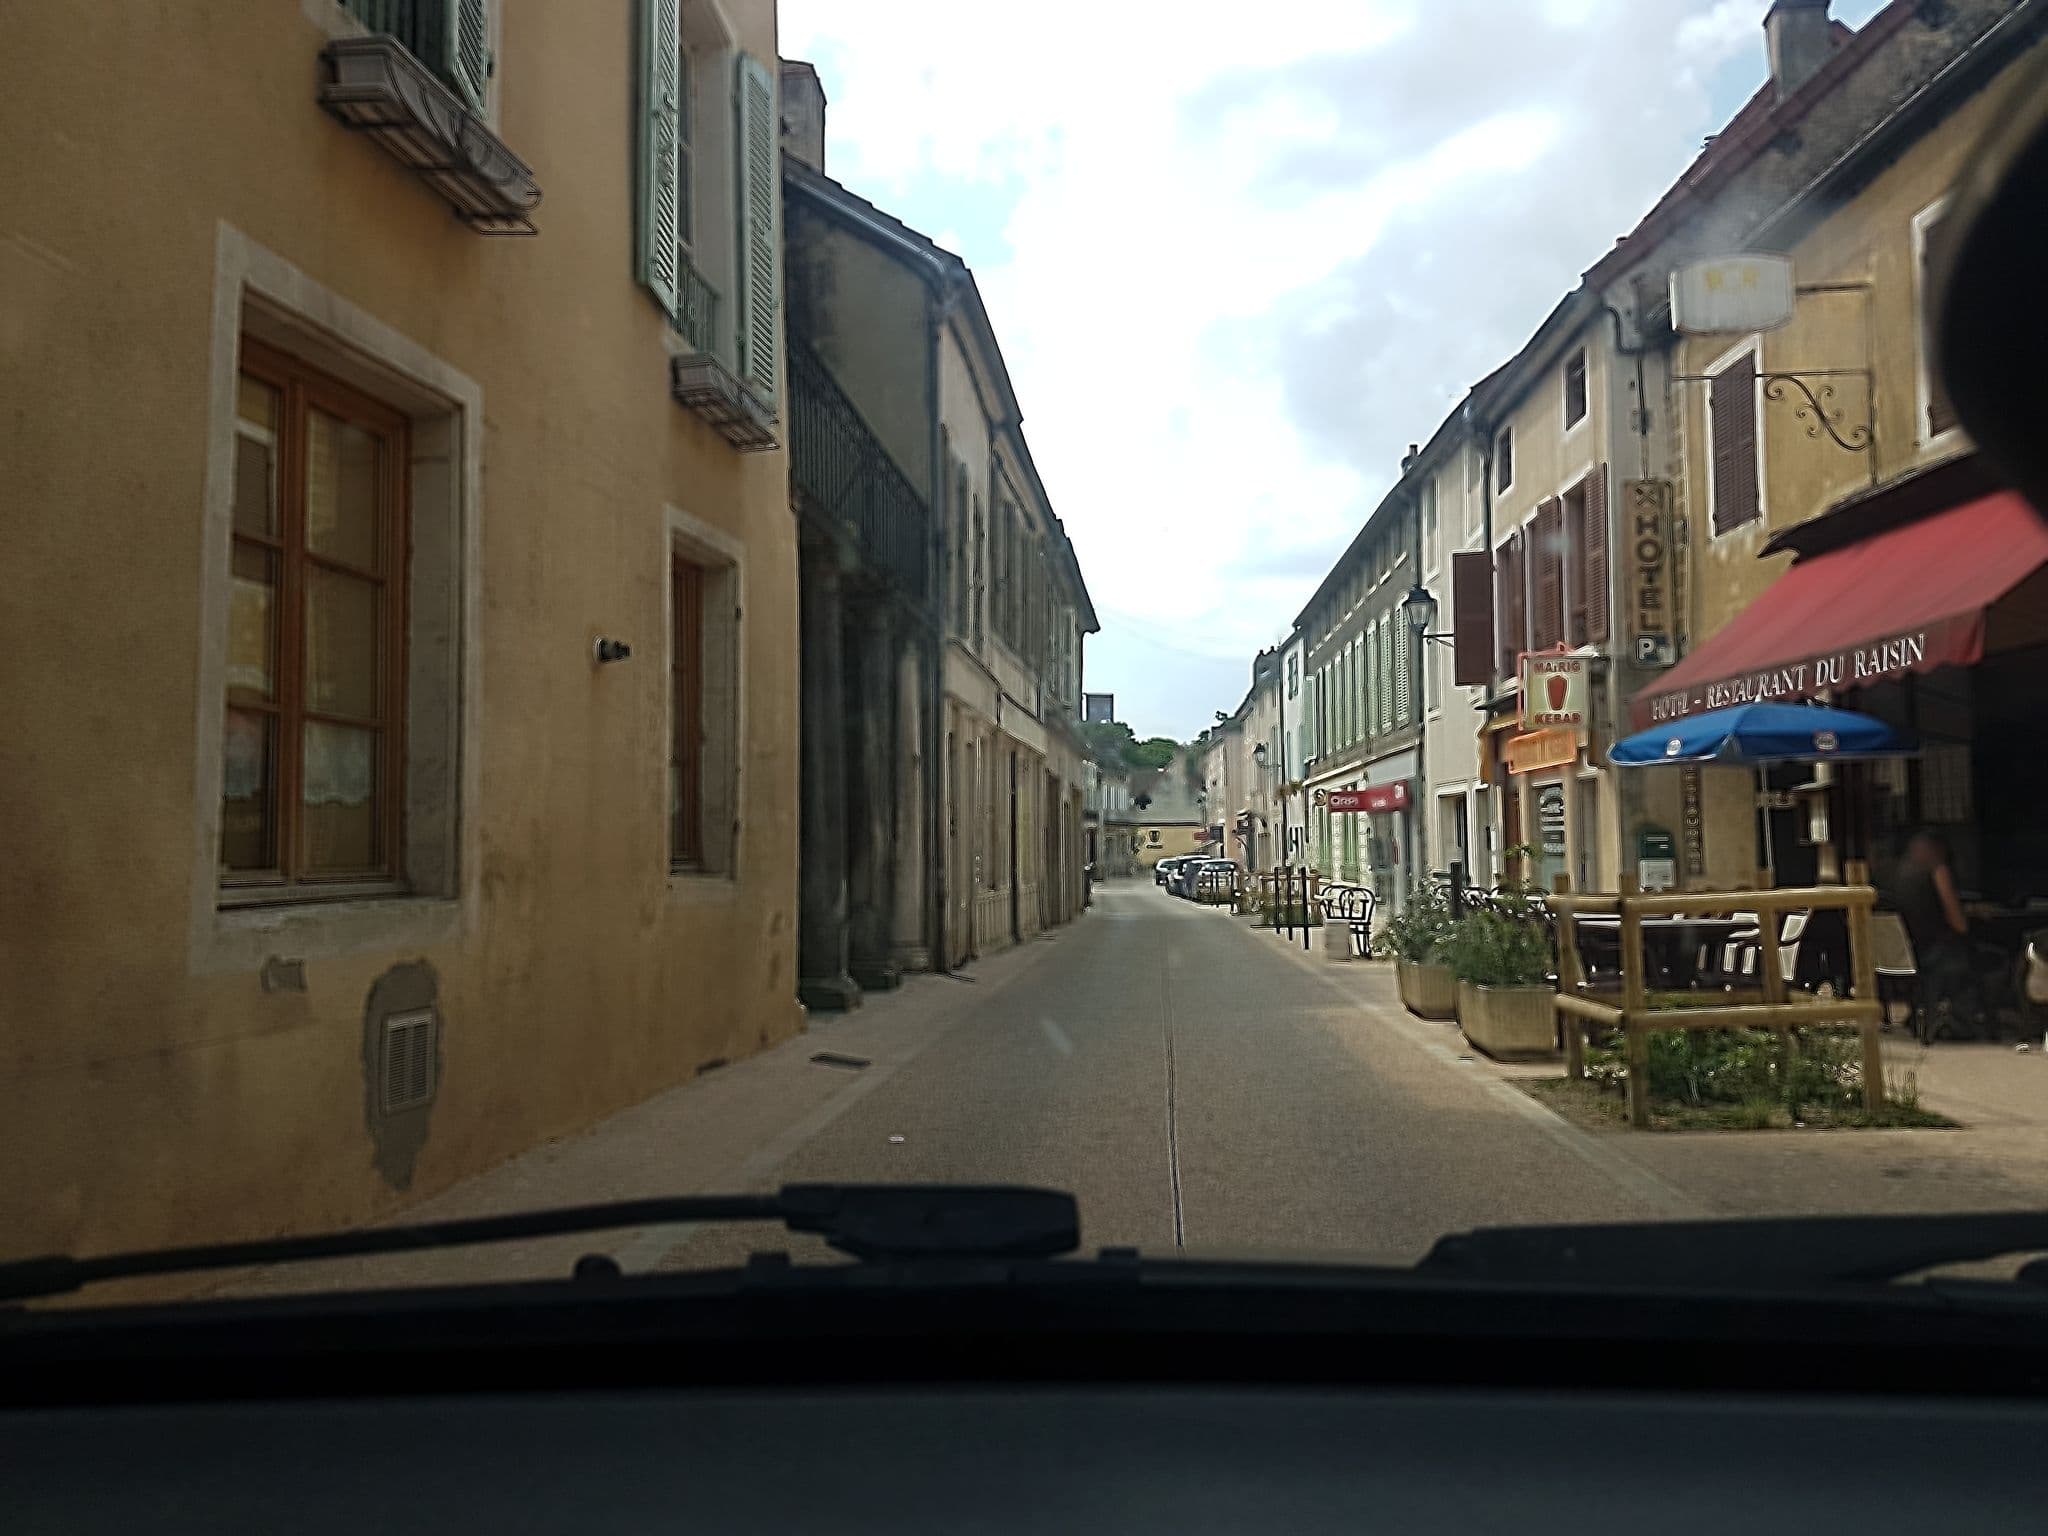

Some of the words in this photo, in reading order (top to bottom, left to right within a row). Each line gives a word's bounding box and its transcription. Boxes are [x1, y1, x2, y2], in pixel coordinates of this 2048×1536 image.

[1635, 514, 1664, 631] HOTEL
[1638, 637, 1655, 661] P
[1706, 664, 1808, 709] RESTAURANT
[1815, 655, 1845, 687] DU
[1854, 632, 1926, 678] RAISIN
[1534, 711, 1582, 725] KEBAB
